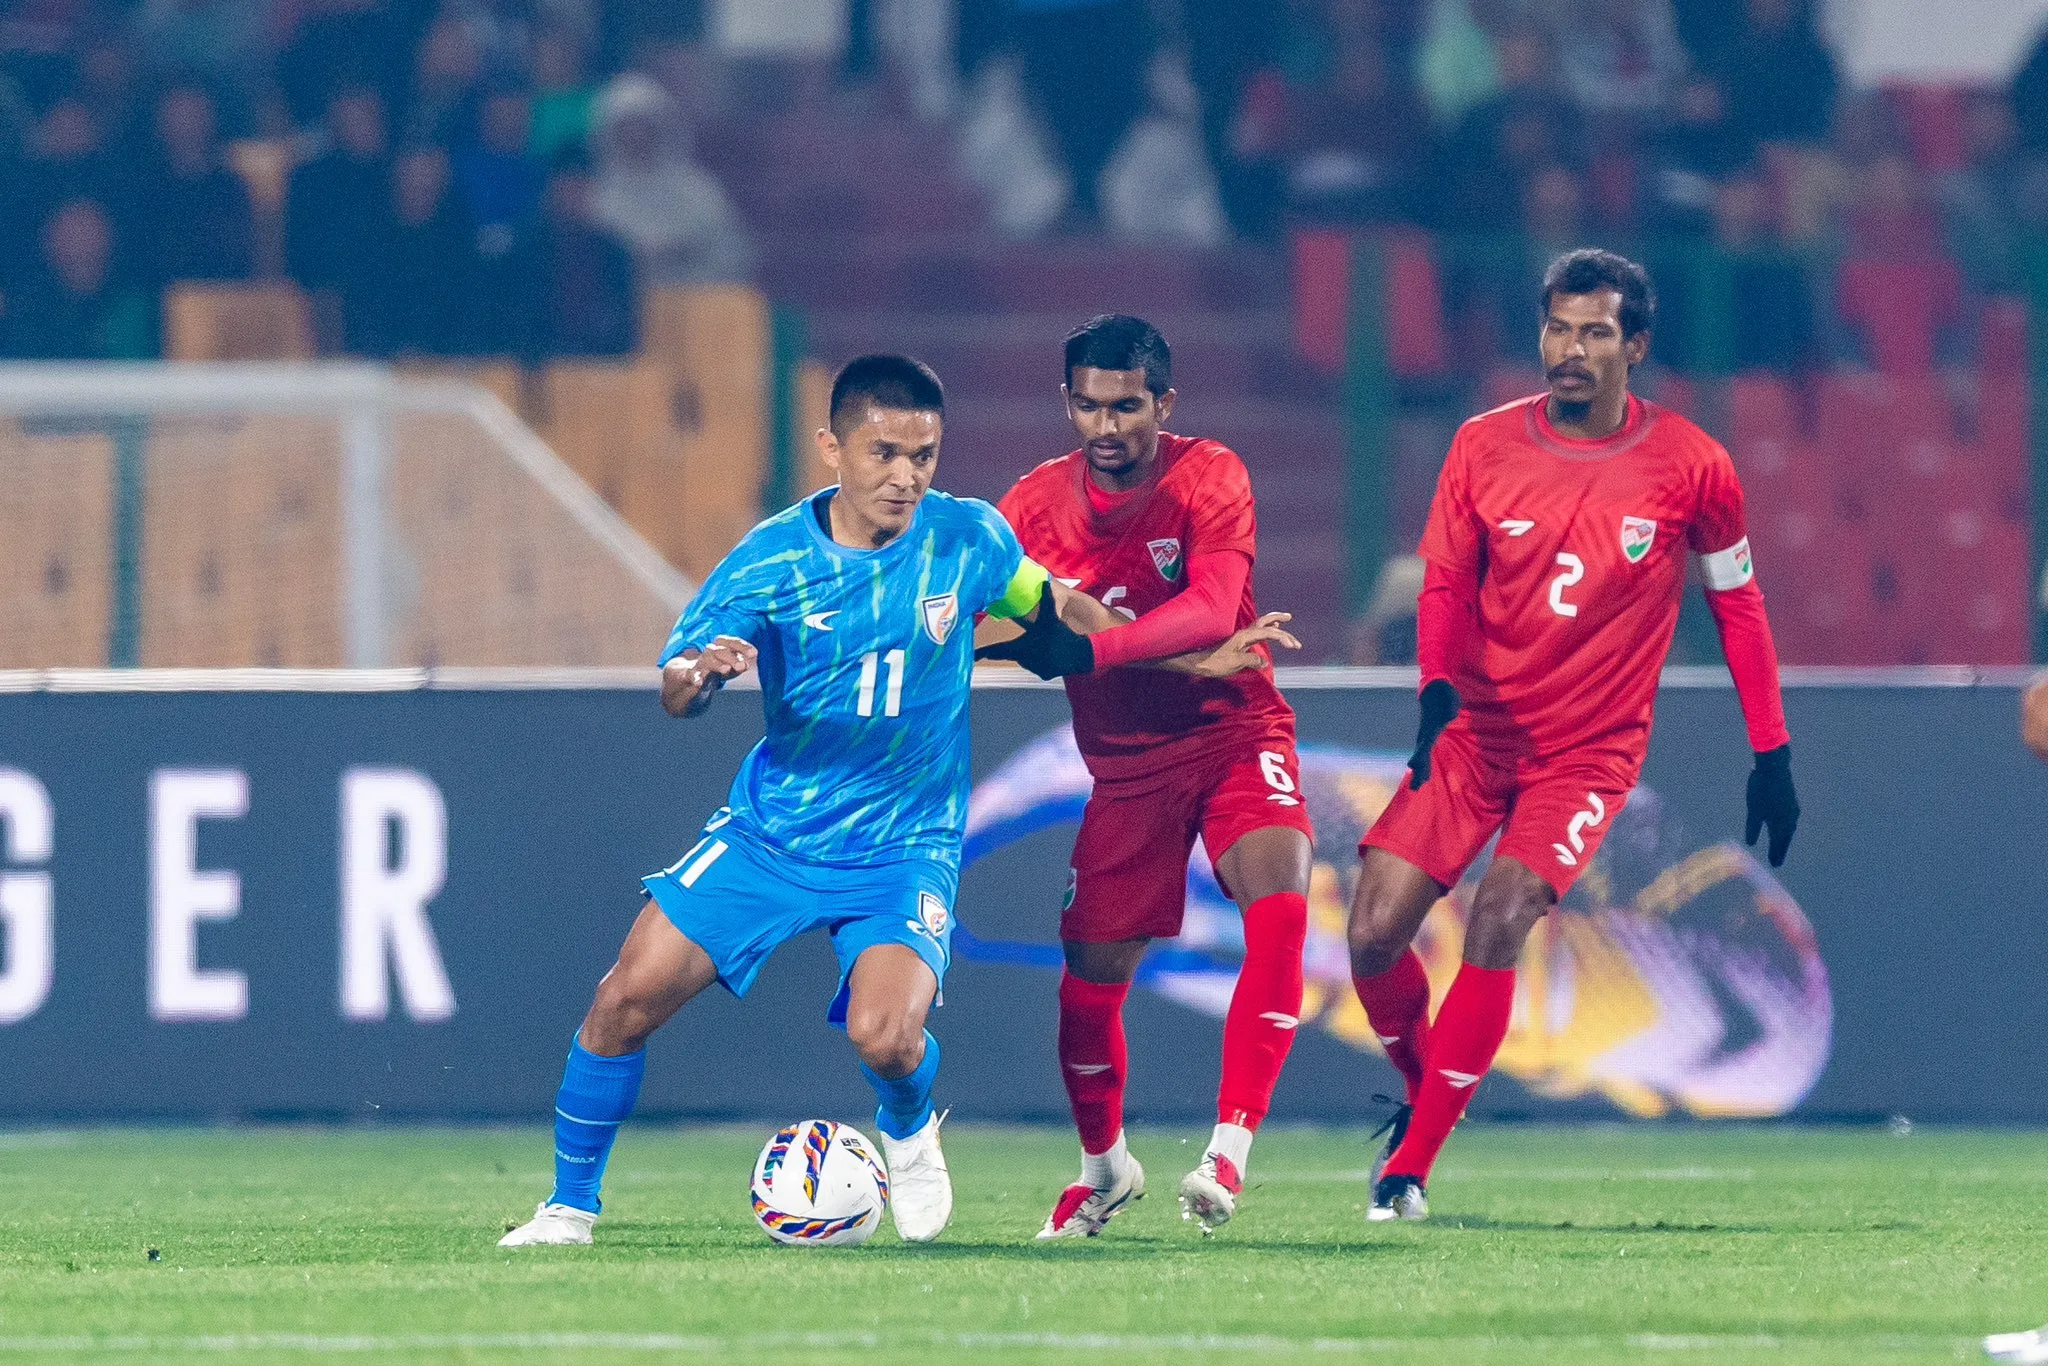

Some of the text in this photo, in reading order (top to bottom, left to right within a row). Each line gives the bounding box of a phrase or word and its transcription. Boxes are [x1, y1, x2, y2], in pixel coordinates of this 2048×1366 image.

[1550, 552, 1585, 617] 2
[857, 649, 905, 717] 11
[1259, 751, 1295, 793] 6
[1567, 792, 1605, 853] 2
